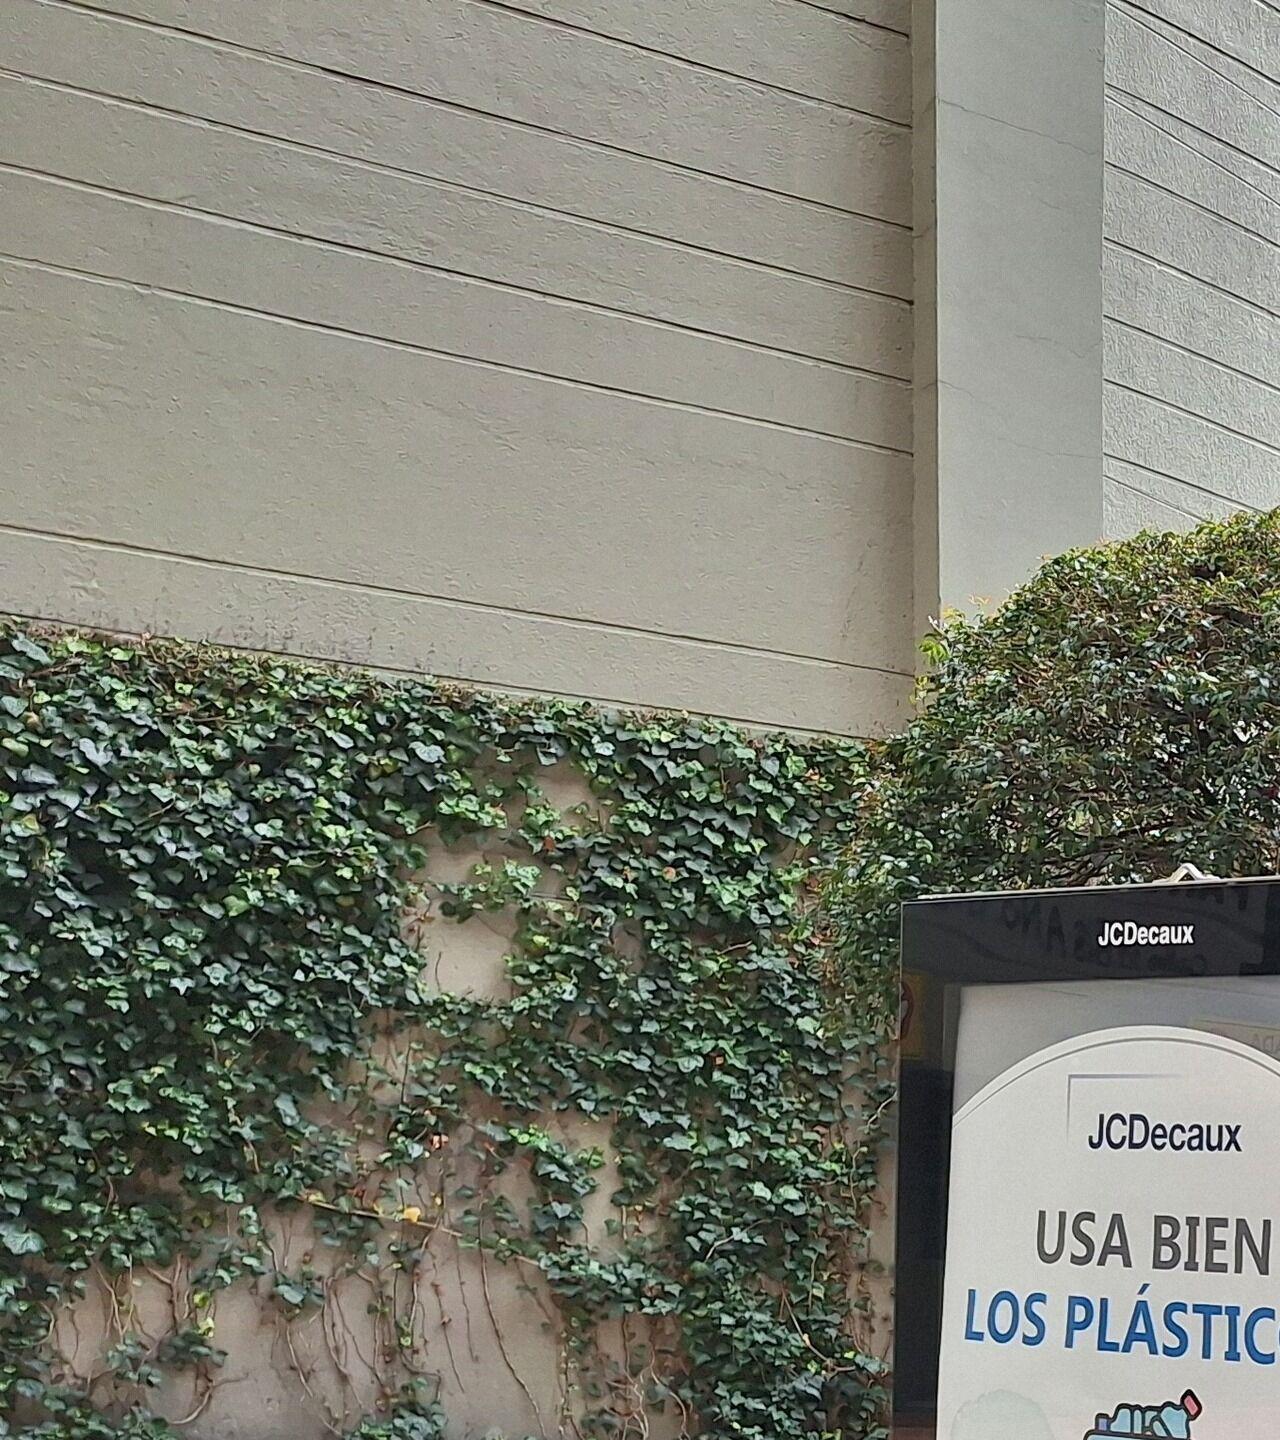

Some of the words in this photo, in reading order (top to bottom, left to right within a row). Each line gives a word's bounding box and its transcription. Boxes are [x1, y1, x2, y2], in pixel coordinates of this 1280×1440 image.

[1097, 920, 1194, 947] JCDecaux
[1087, 1112, 1242, 1153] JCDecaux
[1035, 1208, 1133, 1268] USA
[1151, 1213, 1273, 1276] BIEN
[963, 1287, 1047, 1347] LOS
